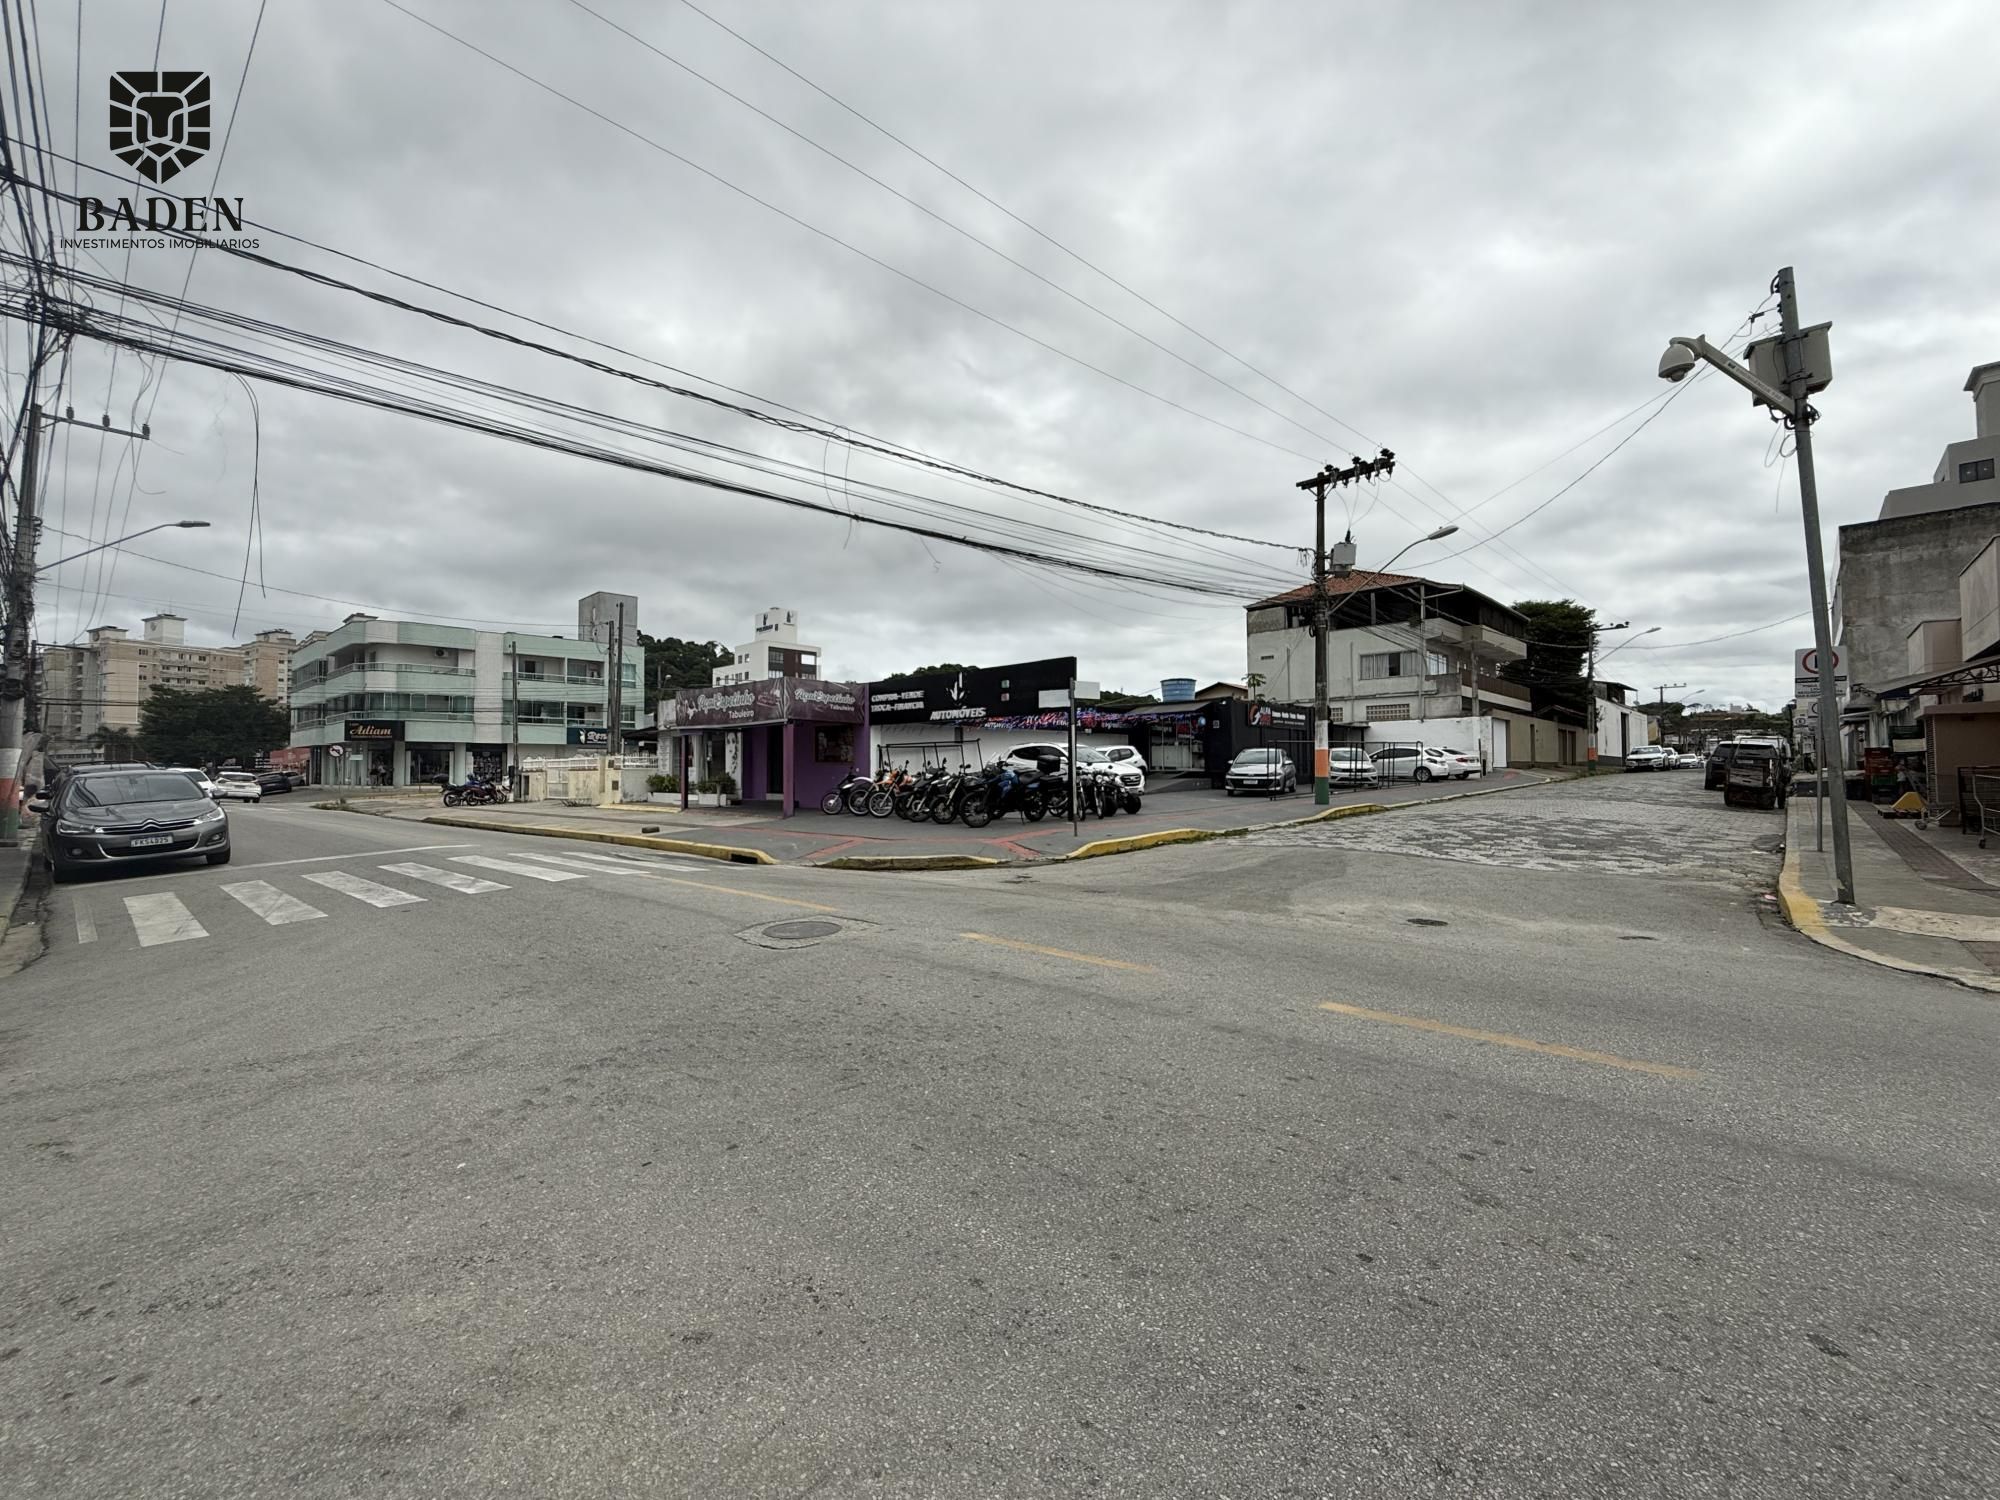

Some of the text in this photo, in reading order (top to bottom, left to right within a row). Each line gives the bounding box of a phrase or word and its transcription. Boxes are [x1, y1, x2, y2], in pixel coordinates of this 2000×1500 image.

[728, 709, 754, 719] Tabuleiro
[929, 706, 987, 720] AUTOMÓVEIS
[349, 725, 392, 736] Adiam
